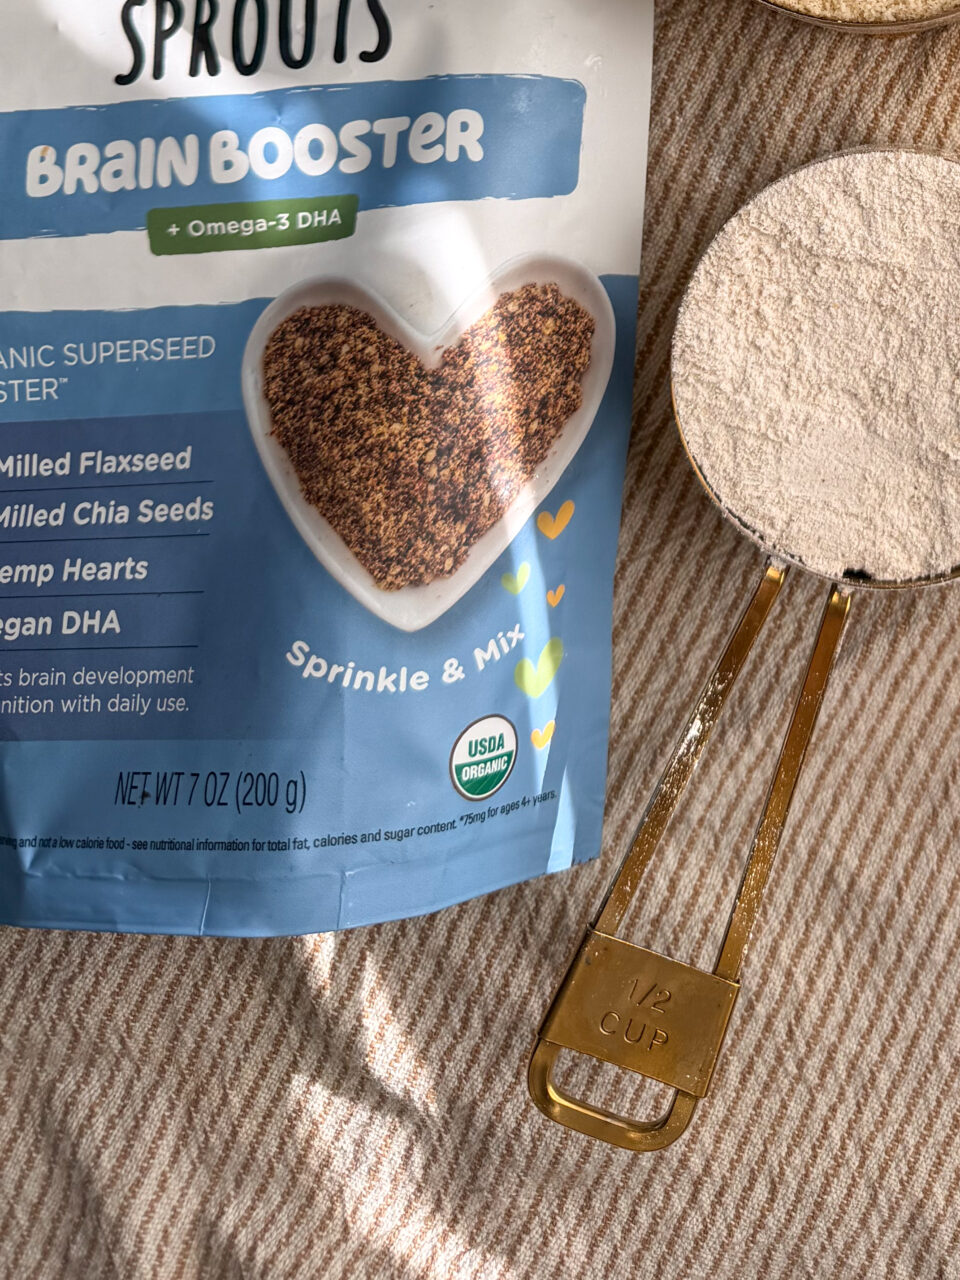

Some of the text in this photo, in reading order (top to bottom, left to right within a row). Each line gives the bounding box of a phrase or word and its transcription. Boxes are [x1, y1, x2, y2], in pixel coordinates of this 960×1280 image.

[188, 213, 290, 239] Omega-3
[296, 208, 342, 230] DHA
[63, 335, 216, 367] SUPERSEED
[79, 445, 193, 475] Flaxseed
[73, 500, 130, 525] Chia
[137, 496, 214, 524] Seeds
[62, 557, 149, 582] Hearts
[0, 609, 121, 641] gan DHA
[286, 623, 525, 693] Sprinkle & Mix
[18, 668, 67, 687] brain
[72, 666, 195, 688] development
[1, 693, 190, 716] nition with daily use.
[467, 732, 505, 758] USDA
[461, 755, 508, 782] ORGANIC
[114, 770, 307, 815] NET WT 7 OZ (200 g)
[18, 835, 38, 848] and
[38, 837, 52, 848] not
[52, 838, 58, 848] a
[58, 835, 74, 848] low
[75, 836, 105, 849] calorie
[106, 837, 126, 850] food
[131, 841, 148, 850] see
[150, 837, 195, 851] nutritional
[196, 838, 250, 852] information
[252, 838, 266, 852] for
[267, 838, 291, 852] total
[292, 837, 311, 851] fat,
[313, 832, 358, 848] calories
[360, 828, 381, 843] and
[384, 826, 415, 842] sugar
[417, 820, 457, 835] content.
[487, 806, 499, 818] for
[500, 802, 520, 815] ages
[532, 788, 558, 807] years.
[627, 978, 672, 1014] 1/2
[599, 1011, 669, 1051] CUP
